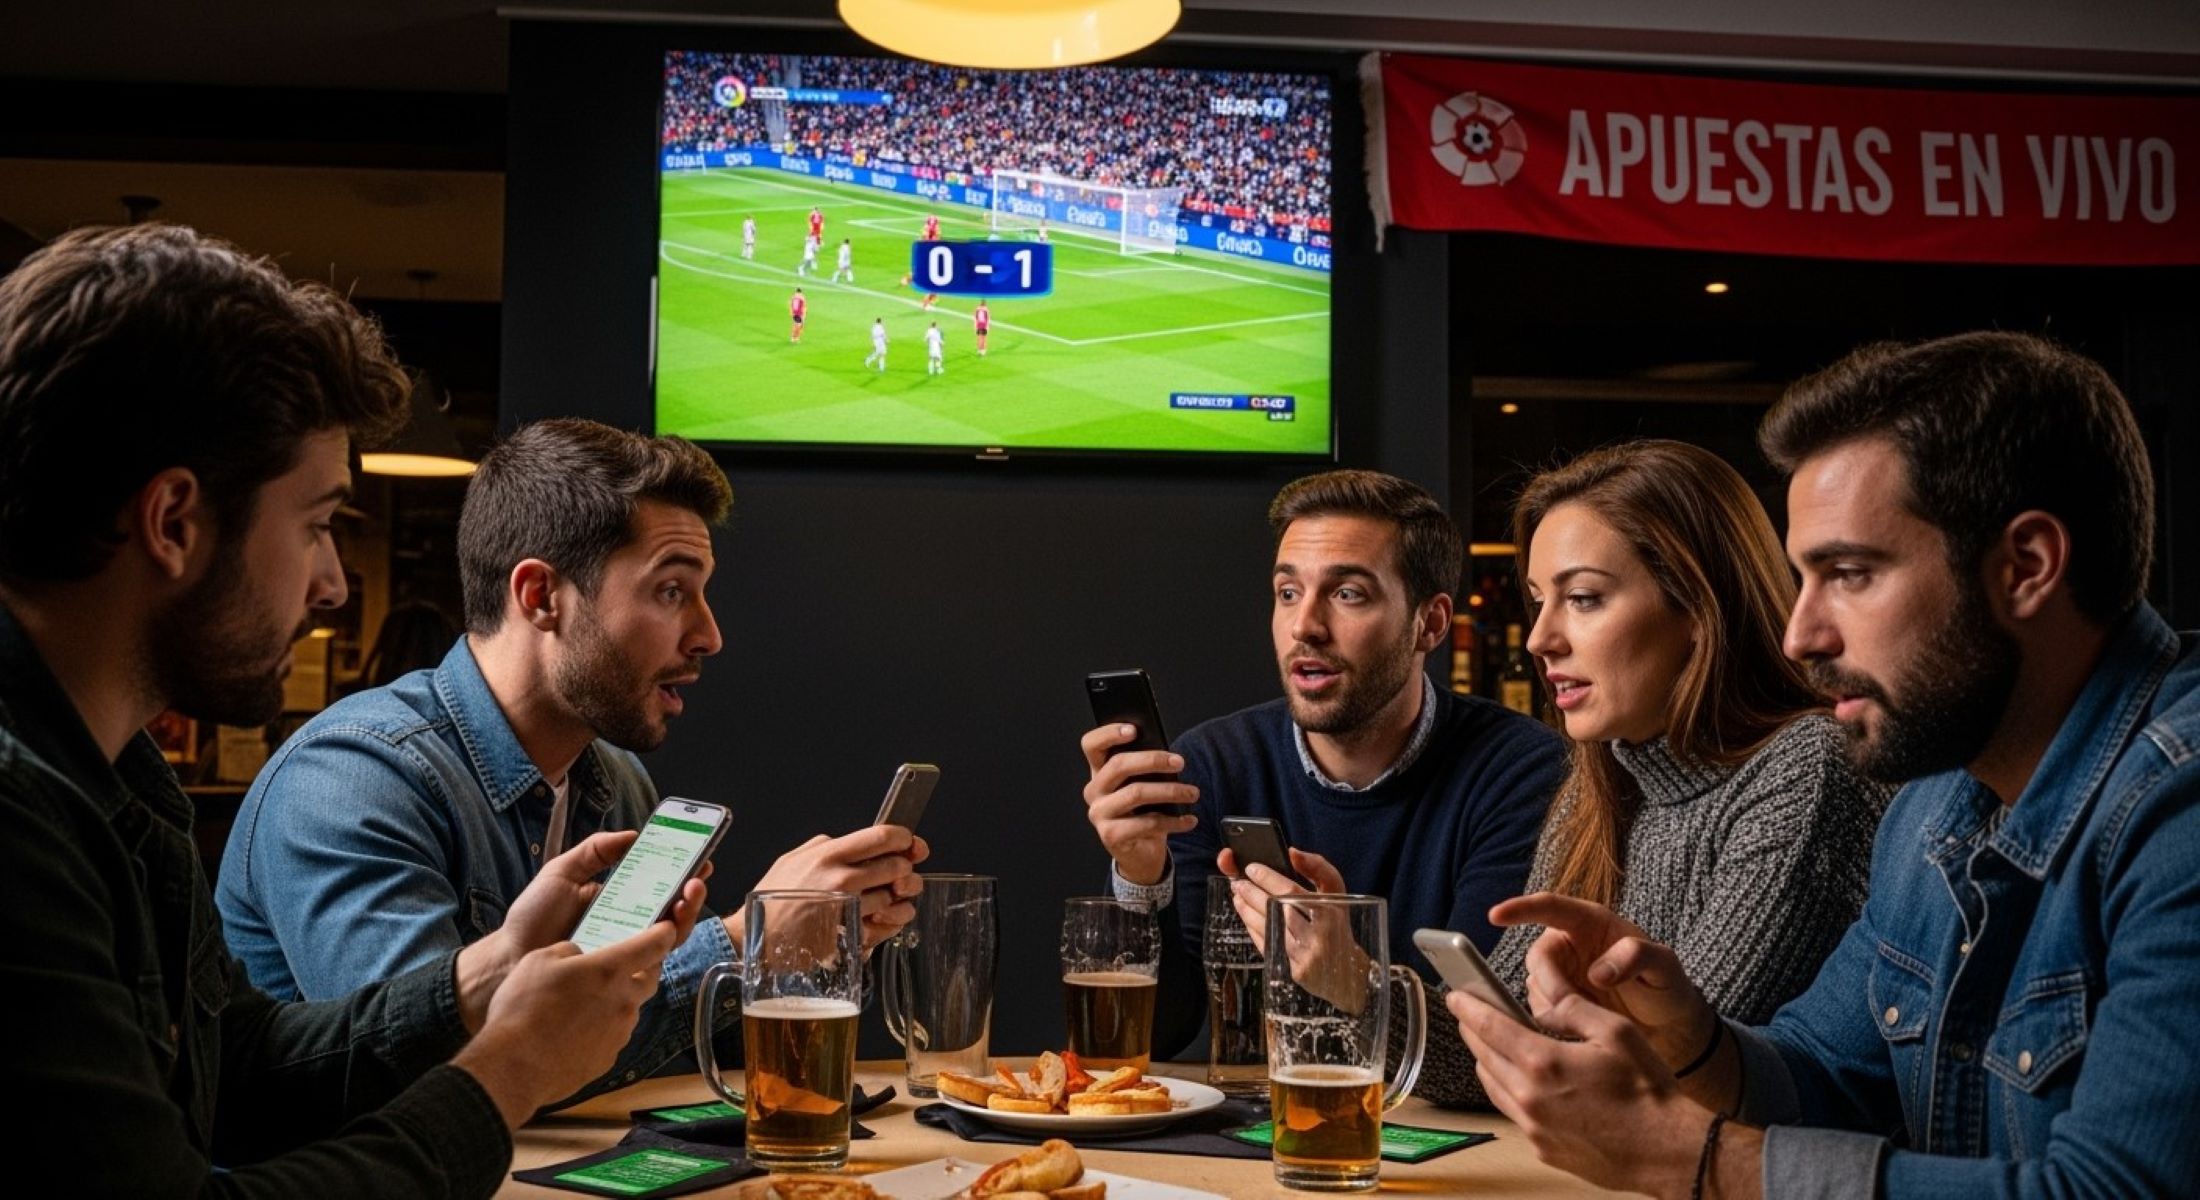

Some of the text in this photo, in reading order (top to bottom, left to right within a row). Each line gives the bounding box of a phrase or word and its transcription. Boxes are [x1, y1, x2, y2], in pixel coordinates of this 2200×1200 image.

[1558, 109, 2176, 224] APUESTAS EN VIVO
[929, 246, 953, 286] 0
[1013, 249, 1032, 288] 1
